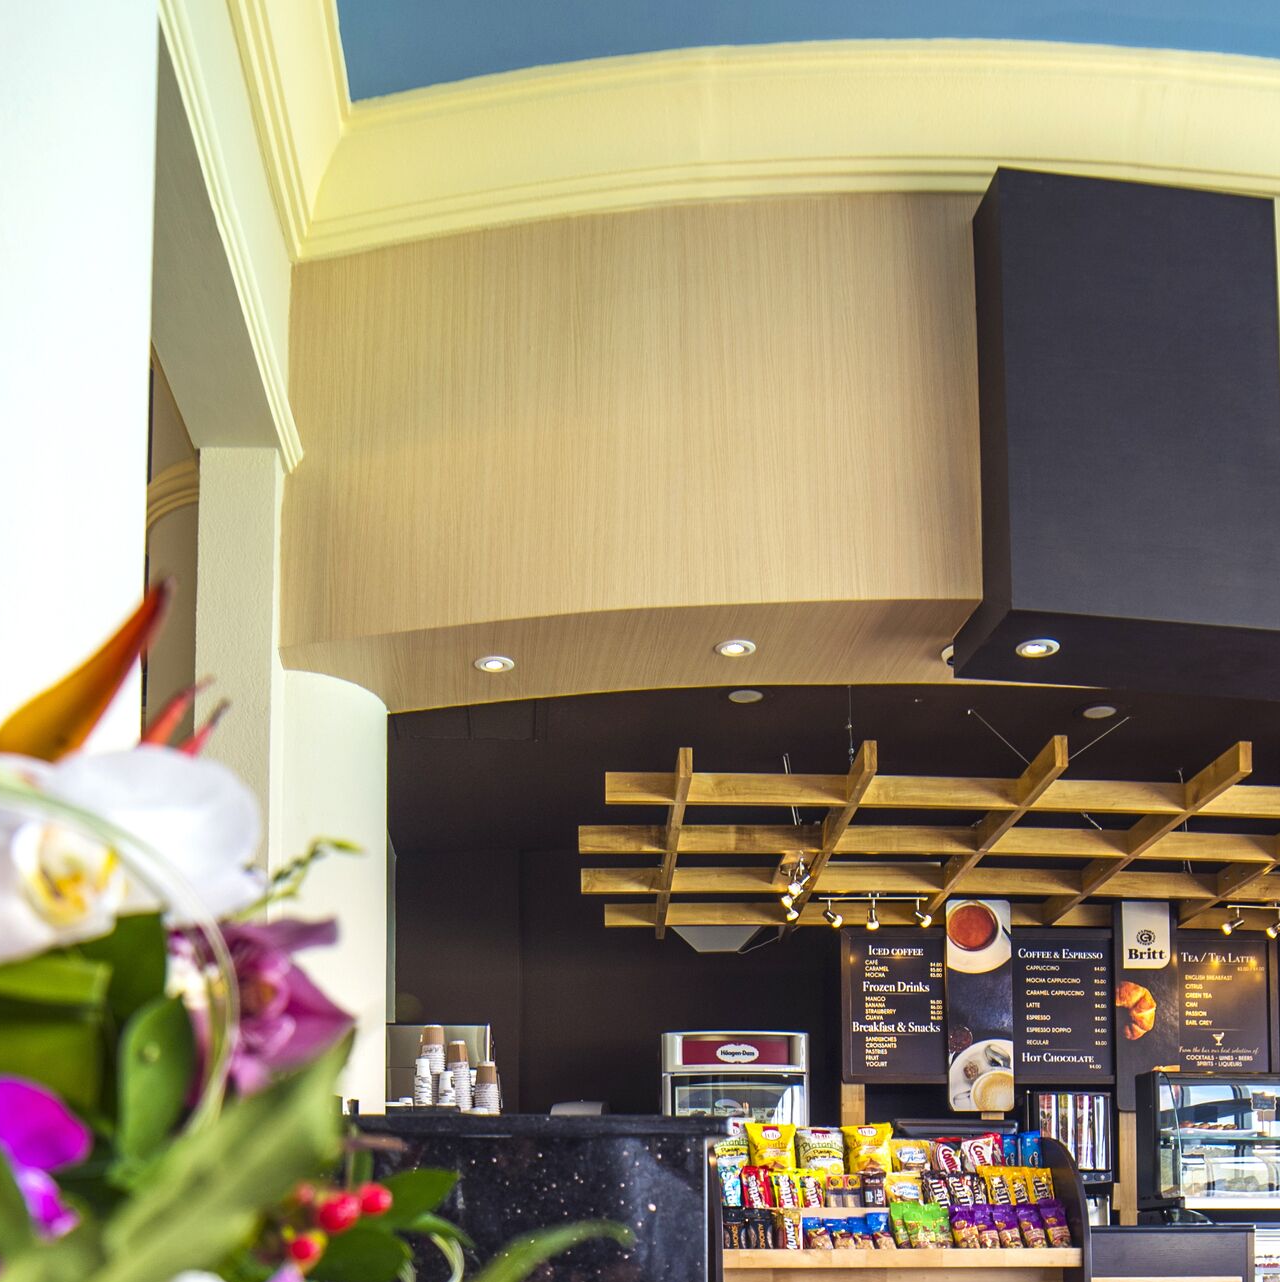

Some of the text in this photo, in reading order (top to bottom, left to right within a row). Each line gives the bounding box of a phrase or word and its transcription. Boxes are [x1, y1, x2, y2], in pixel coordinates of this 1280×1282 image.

[868, 945, 924, 956] ICED COFFEE
[1018, 948, 1052, 959] COFFEE
[1062, 948, 1103, 960] ESPRESSO
[1128, 947, 1165, 960] Britt
[1181, 952, 1199, 963] TEA
[1200, 952, 1207, 963] /
[1208, 952, 1226, 963] TEA
[863, 981, 930, 993] Frozen Drinks
[852, 1022, 941, 1033] Breakfast & Snacks
[720, 1050, 755, 1058] Häagen-Dazs
[1022, 1052, 1095, 1063] HOT CHOCOLATE
